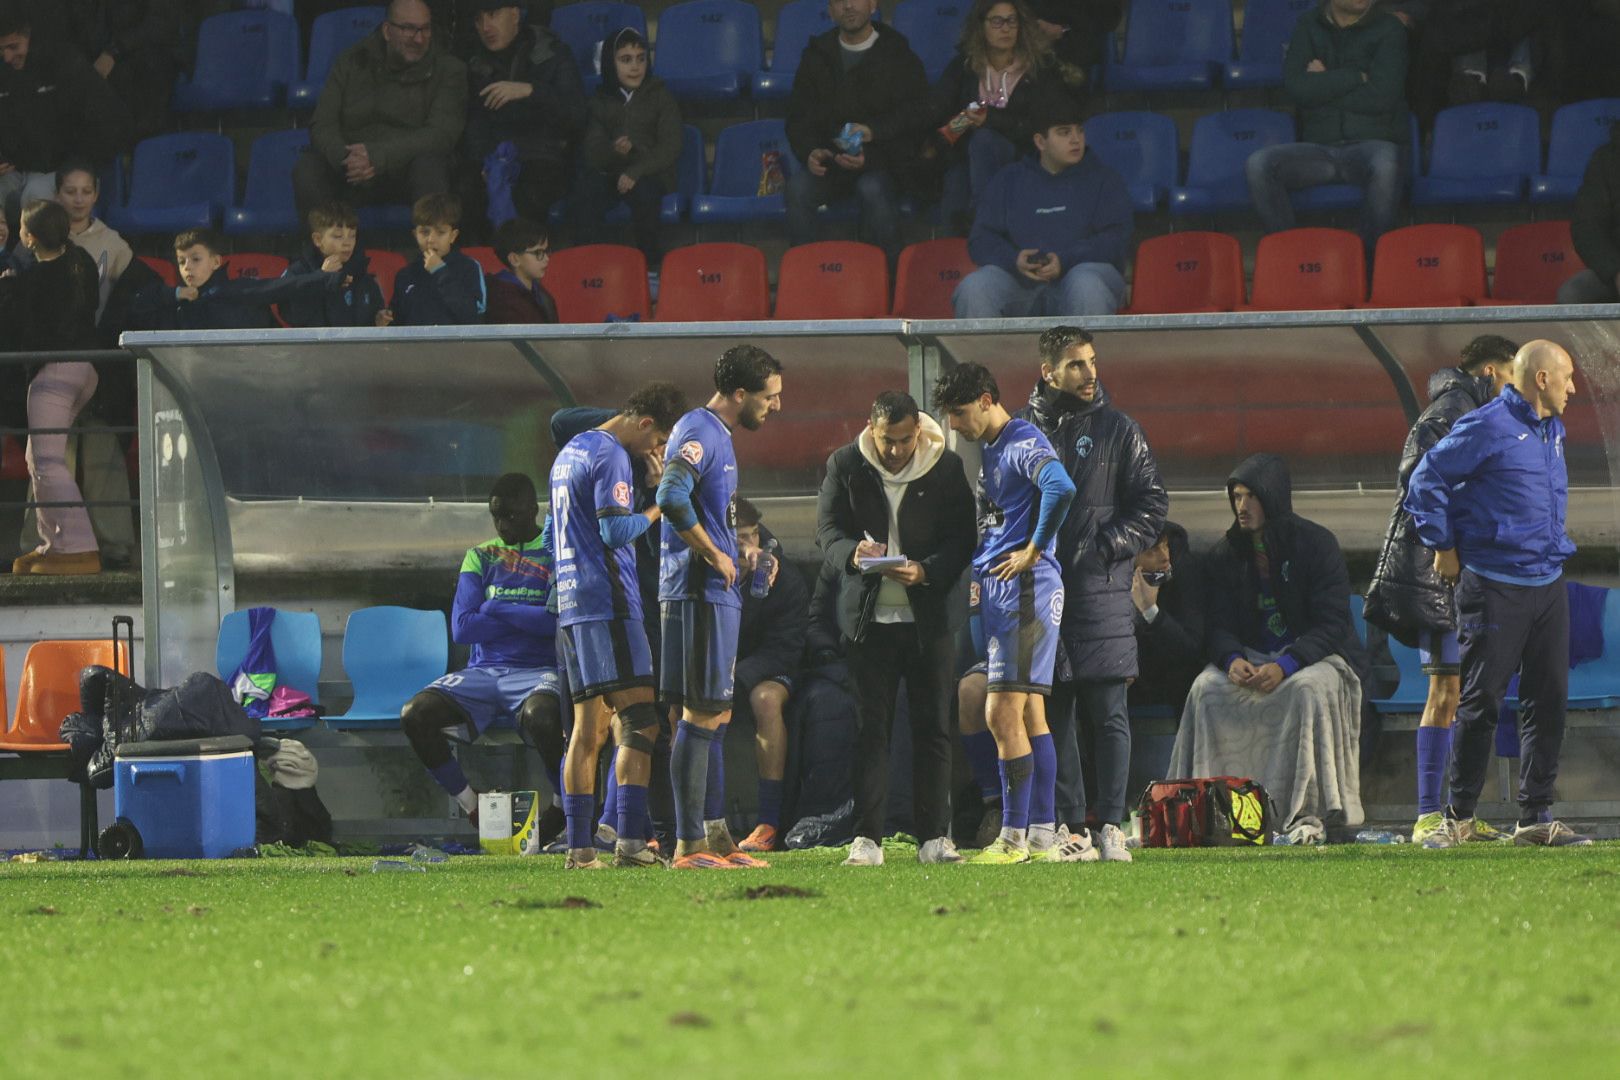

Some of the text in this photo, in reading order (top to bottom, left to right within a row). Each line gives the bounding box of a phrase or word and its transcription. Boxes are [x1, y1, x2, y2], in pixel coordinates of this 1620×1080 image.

[1176, 260, 1199, 272] 137
[1417, 257, 1440, 267] 135
[819, 263, 842, 273] 140
[1298, 262, 1321, 273] 136
[582, 278, 604, 288] 142
[701, 274, 721, 284] 141
